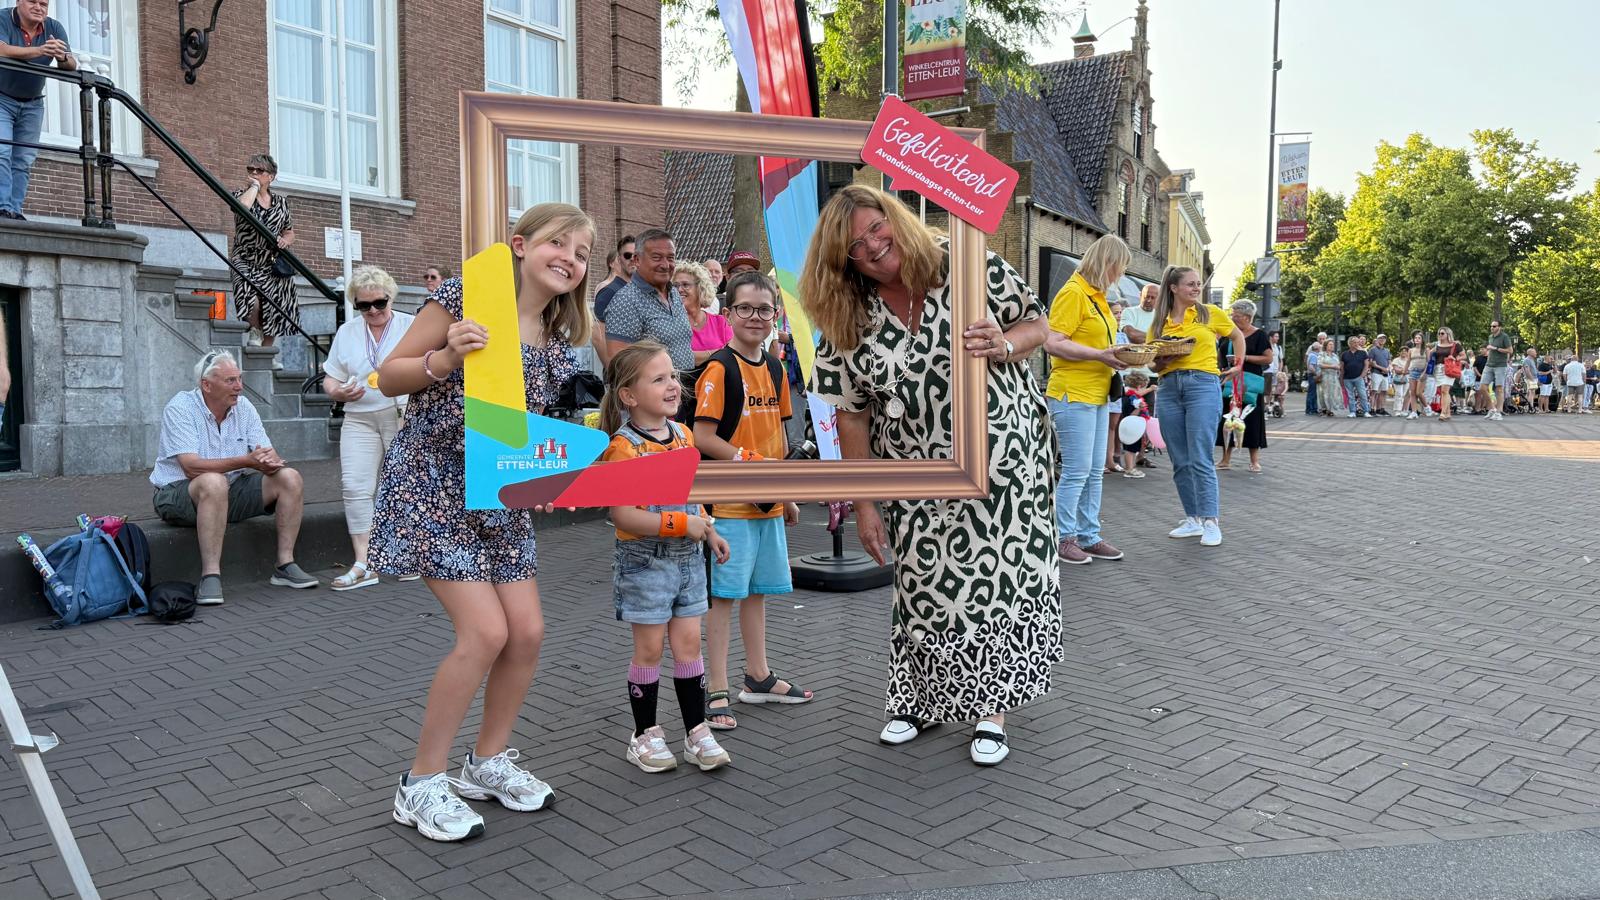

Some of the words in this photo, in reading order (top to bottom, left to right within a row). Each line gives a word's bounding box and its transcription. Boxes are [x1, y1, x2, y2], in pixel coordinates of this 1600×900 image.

[908, 59, 960, 71] WINKELCENTRUM
[908, 66, 960, 83] ETTEN-LEUR
[883, 117, 1006, 198] Gefeliciteerd
[1281, 164, 1306, 178] ETTEN
[1282, 172, 1304, 184] LEUR
[875, 147, 943, 192] Avondvierdaagse
[943, 188, 984, 216] Etten-Leur
[496, 460, 569, 470] ETTEN-LEUR
